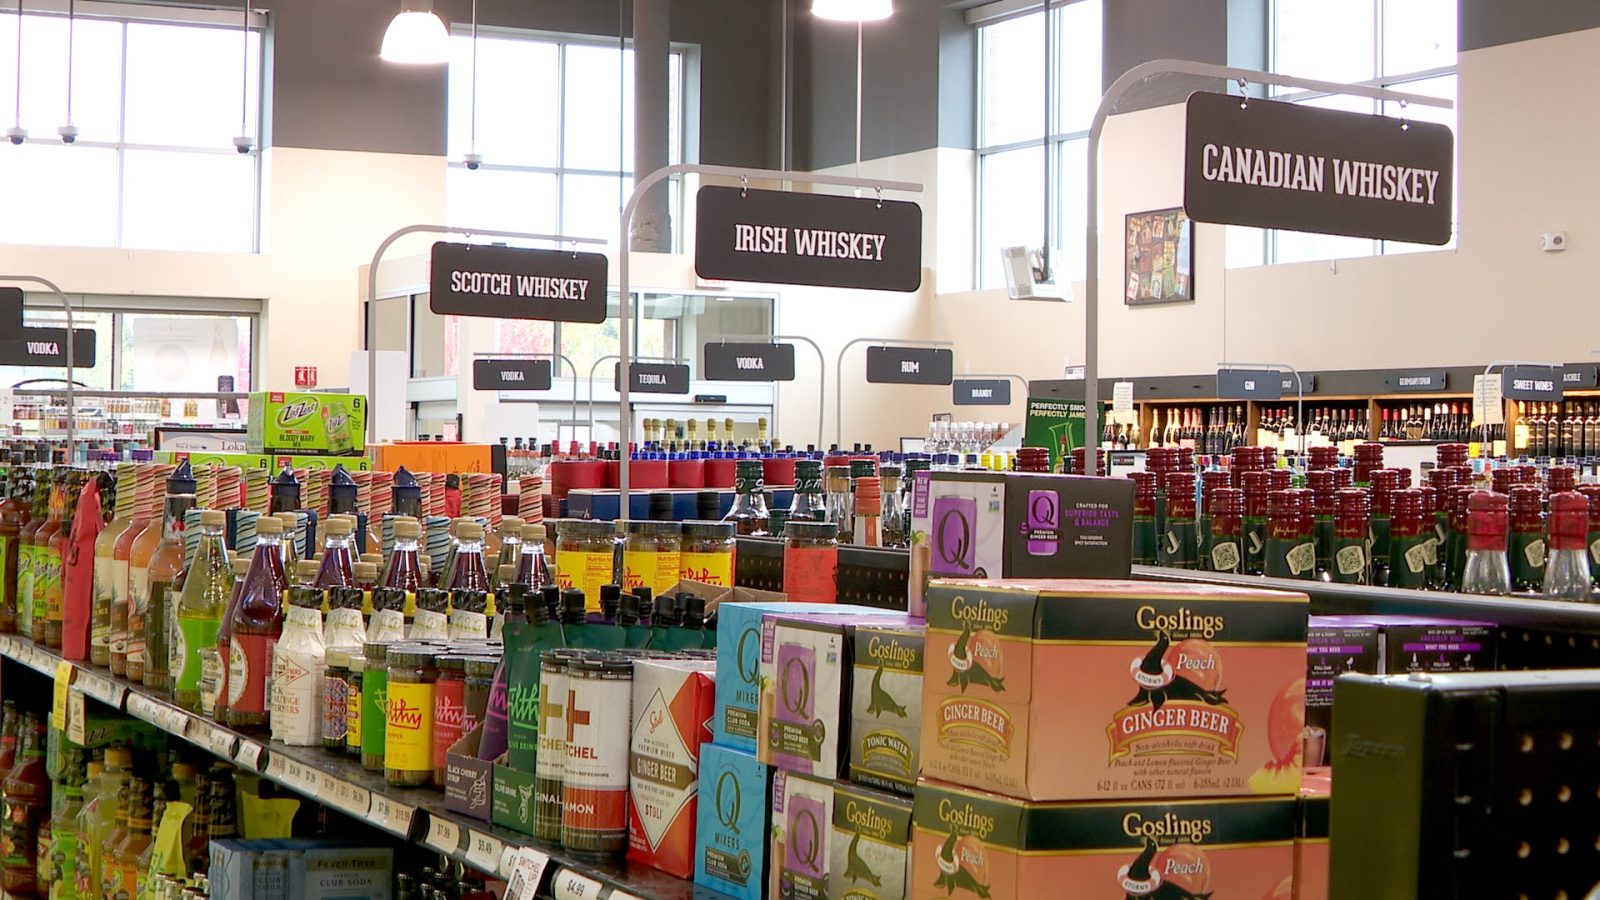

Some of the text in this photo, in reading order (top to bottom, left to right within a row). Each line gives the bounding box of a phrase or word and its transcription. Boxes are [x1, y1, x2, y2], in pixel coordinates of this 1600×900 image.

[1202, 143, 1439, 206] CANADIAN WHISKEY
[734, 224, 886, 261] IRISH WHISKEY
[450, 270, 589, 301] SCOTCH WHISKEY
[26, 341, 60, 356] VODKA
[735, 357, 764, 370] VODKA
[901, 360, 920, 374] RUM
[500, 370, 525, 382] VODKA
[638, 373, 667, 386] TEQUILA
[1244, 380, 1255, 391] GIN
[1513, 379, 1554, 392] SWEET WINES
[971, 388, 993, 398] BRANDY
[354, 398, 361, 409] 6
[1031, 402, 1069, 411] PERFECTLY
[1030, 409, 1068, 418] PERFECTLY
[279, 434, 299, 442] BLOODY
[1032, 496, 1055, 526] Q
[1065, 509, 1120, 518] SUPERIOR TASTE
[1082, 519, 1109, 527] BALANCE
[938, 509, 970, 570] Q
[951, 595, 1009, 631] Goslings
[1136, 605, 1224, 639] Goslings
[868, 636, 917, 669] Goslings
[974, 641, 998, 659] Peach
[1176, 653, 1216, 670] Peach
[1137, 673, 1161, 684] STORMY
[781, 657, 809, 720] Q
[727, 709, 747, 719] PREMIUM
[944, 703, 1005, 734] GINGER BEER
[727, 717, 751, 727] CLUB SODA
[1122, 708, 1230, 735] GINGER BEER
[783, 725, 802, 735] PREMIUM
[783, 732, 809, 745] GINGER BEER
[638, 744, 675, 759] PREMIUM MIXER
[866, 736, 909, 757] TONIC WATER
[1114, 757, 1232, 768] Peach and Lemon flavored Ginger Beer
[447, 765, 477, 779] BLACK CHERRY
[637, 758, 676, 783] GINGER BEER
[1134, 768, 1148, 776] with
[1167, 768, 1189, 776] natural
[447, 773, 460, 783] SYRUP
[1130, 779, 1152, 790] CANS
[716, 771, 741, 835] Q
[645, 804, 664, 820] STOLI
[939, 798, 994, 838] Goslings
[846, 800, 893, 839] Goslings
[437, 823, 450, 841] $7.99
[1122, 812, 1212, 842] Goslings
[478, 839, 492, 855] $5.49
[715, 832, 740, 851] MIXERS
[791, 808, 819, 873] Q
[707, 850, 725, 861] PREMIUM
[961, 846, 984, 866] Peach
[318, 860, 376, 868] FEVER-TREE
[706, 857, 728, 870] CLUB SODA
[1164, 857, 1204, 875] Peach
[320, 878, 373, 887] CLUB SODA
[794, 875, 812, 886] PREMIUM
[1124, 881, 1149, 891] STORMY
[566, 879, 585, 897] $4.99
[794, 884, 819, 896] GINGER BEER
